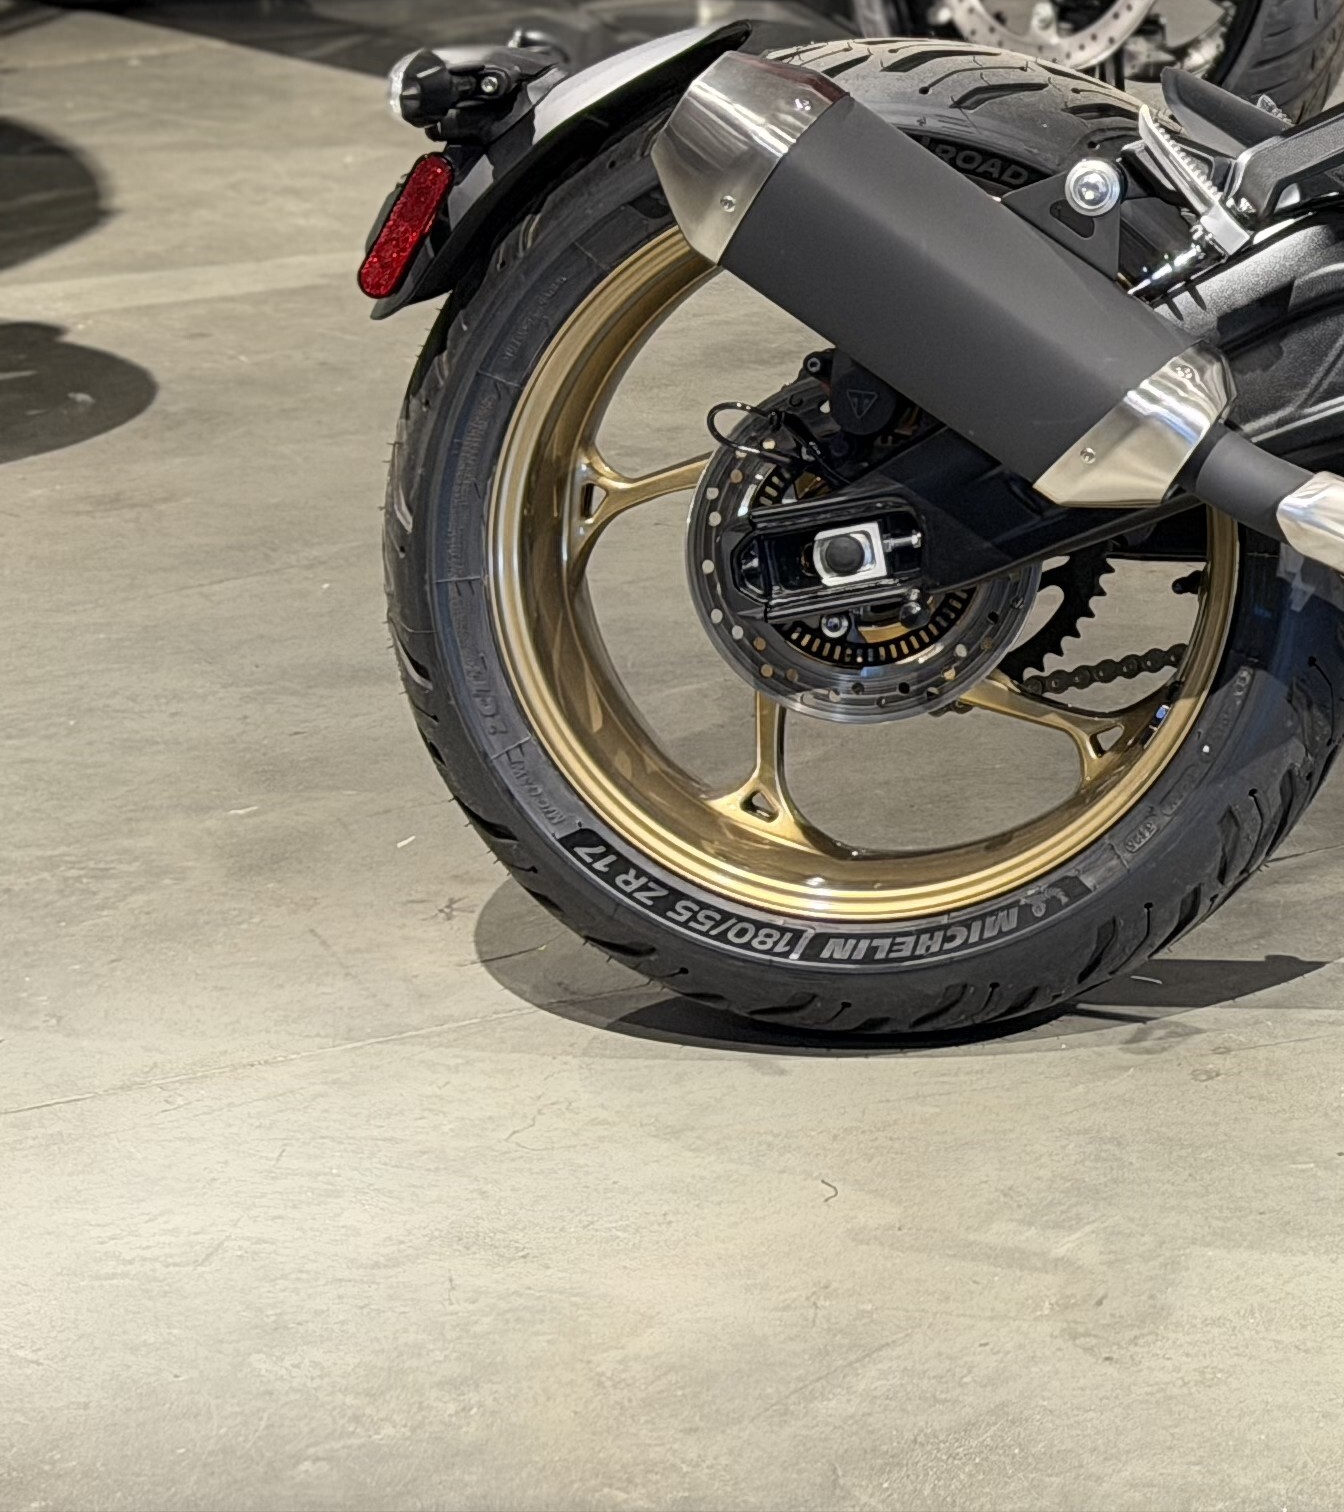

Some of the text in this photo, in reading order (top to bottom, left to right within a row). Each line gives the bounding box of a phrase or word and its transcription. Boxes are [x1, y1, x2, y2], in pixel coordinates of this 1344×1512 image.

[935, 144, 1029, 185] ROAD
[572, 844, 795, 954] 180/55 ZR 17
[818, 906, 1020, 961] MICHELIN
